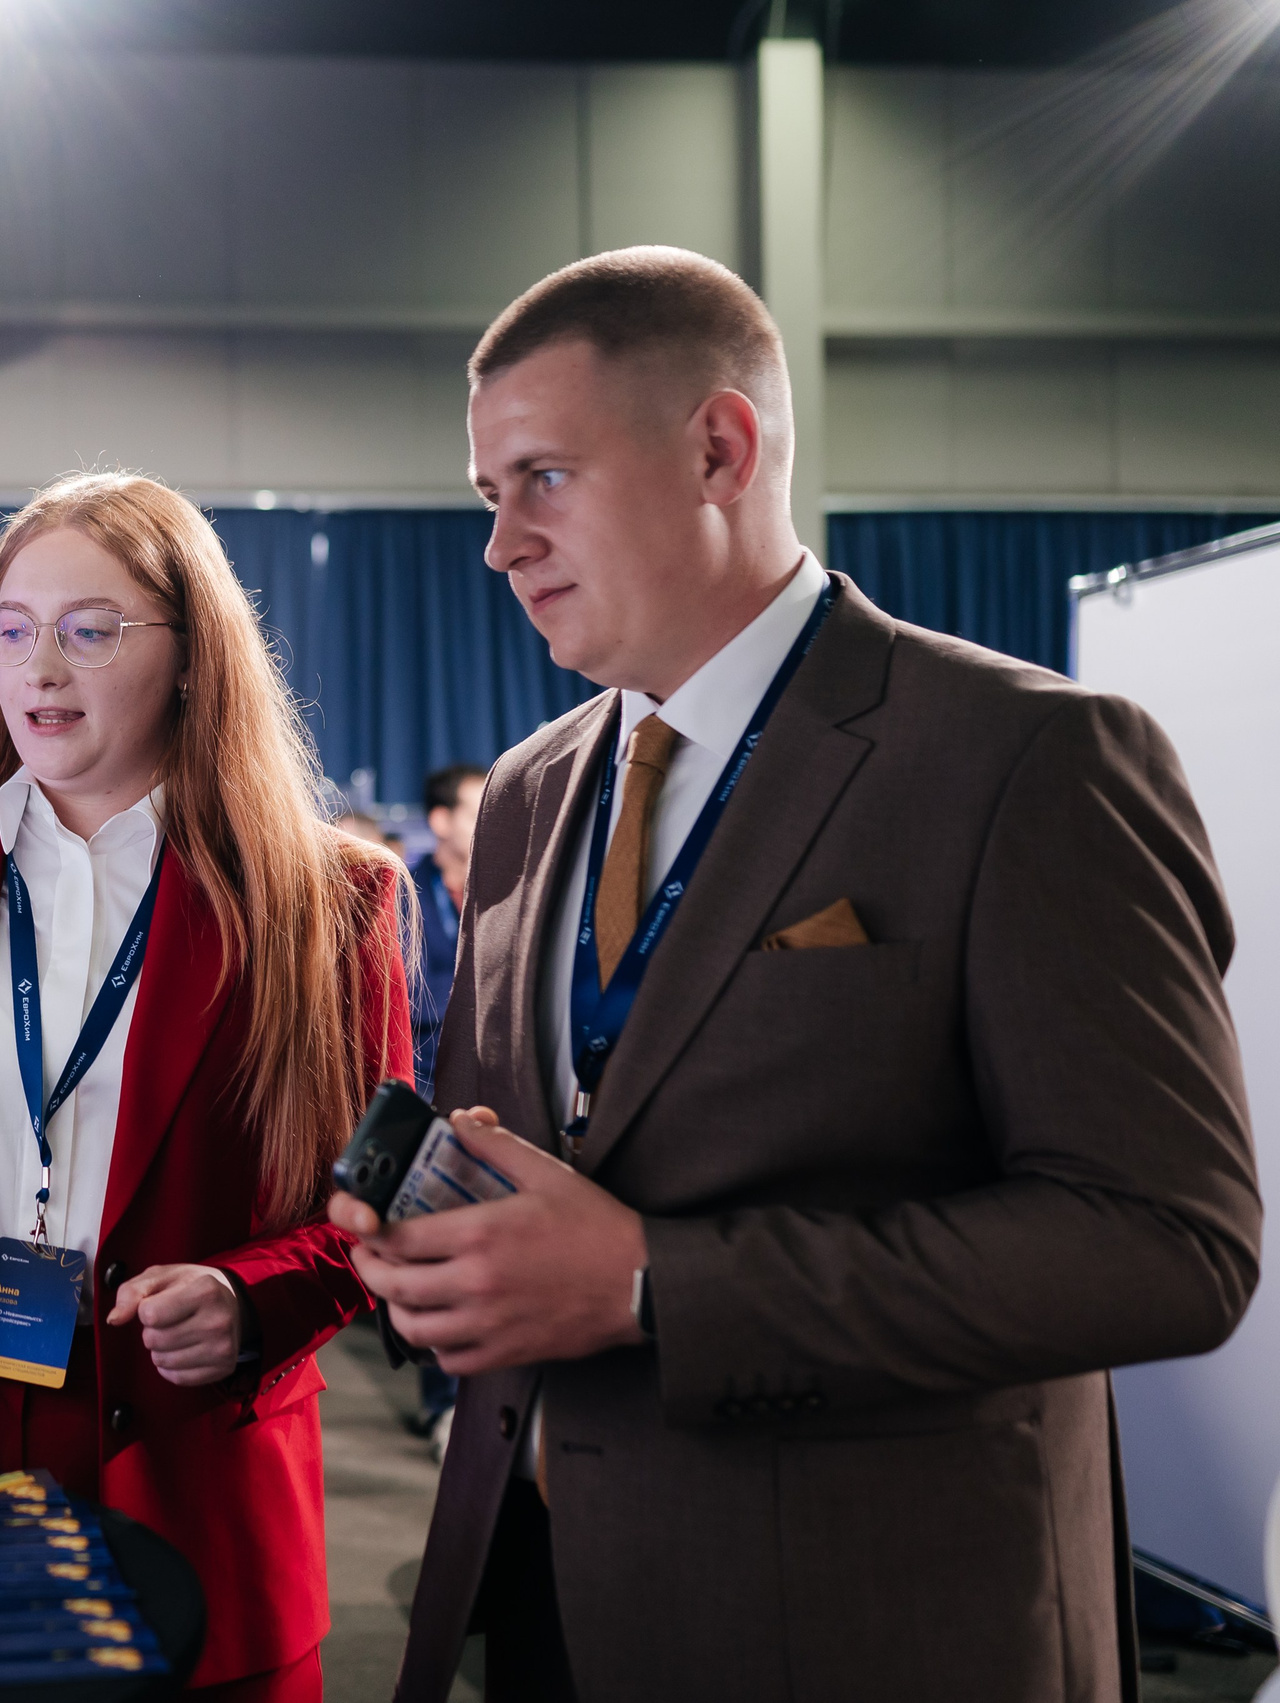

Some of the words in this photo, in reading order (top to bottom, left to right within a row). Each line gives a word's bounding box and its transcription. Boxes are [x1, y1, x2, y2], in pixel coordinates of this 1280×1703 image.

[121, 931, 143, 972] ЕВРОХИМ
[22, 997, 31, 1041] ЕВРОХИМ
[60, 1052, 87, 1094] ЕВРОХИМ
